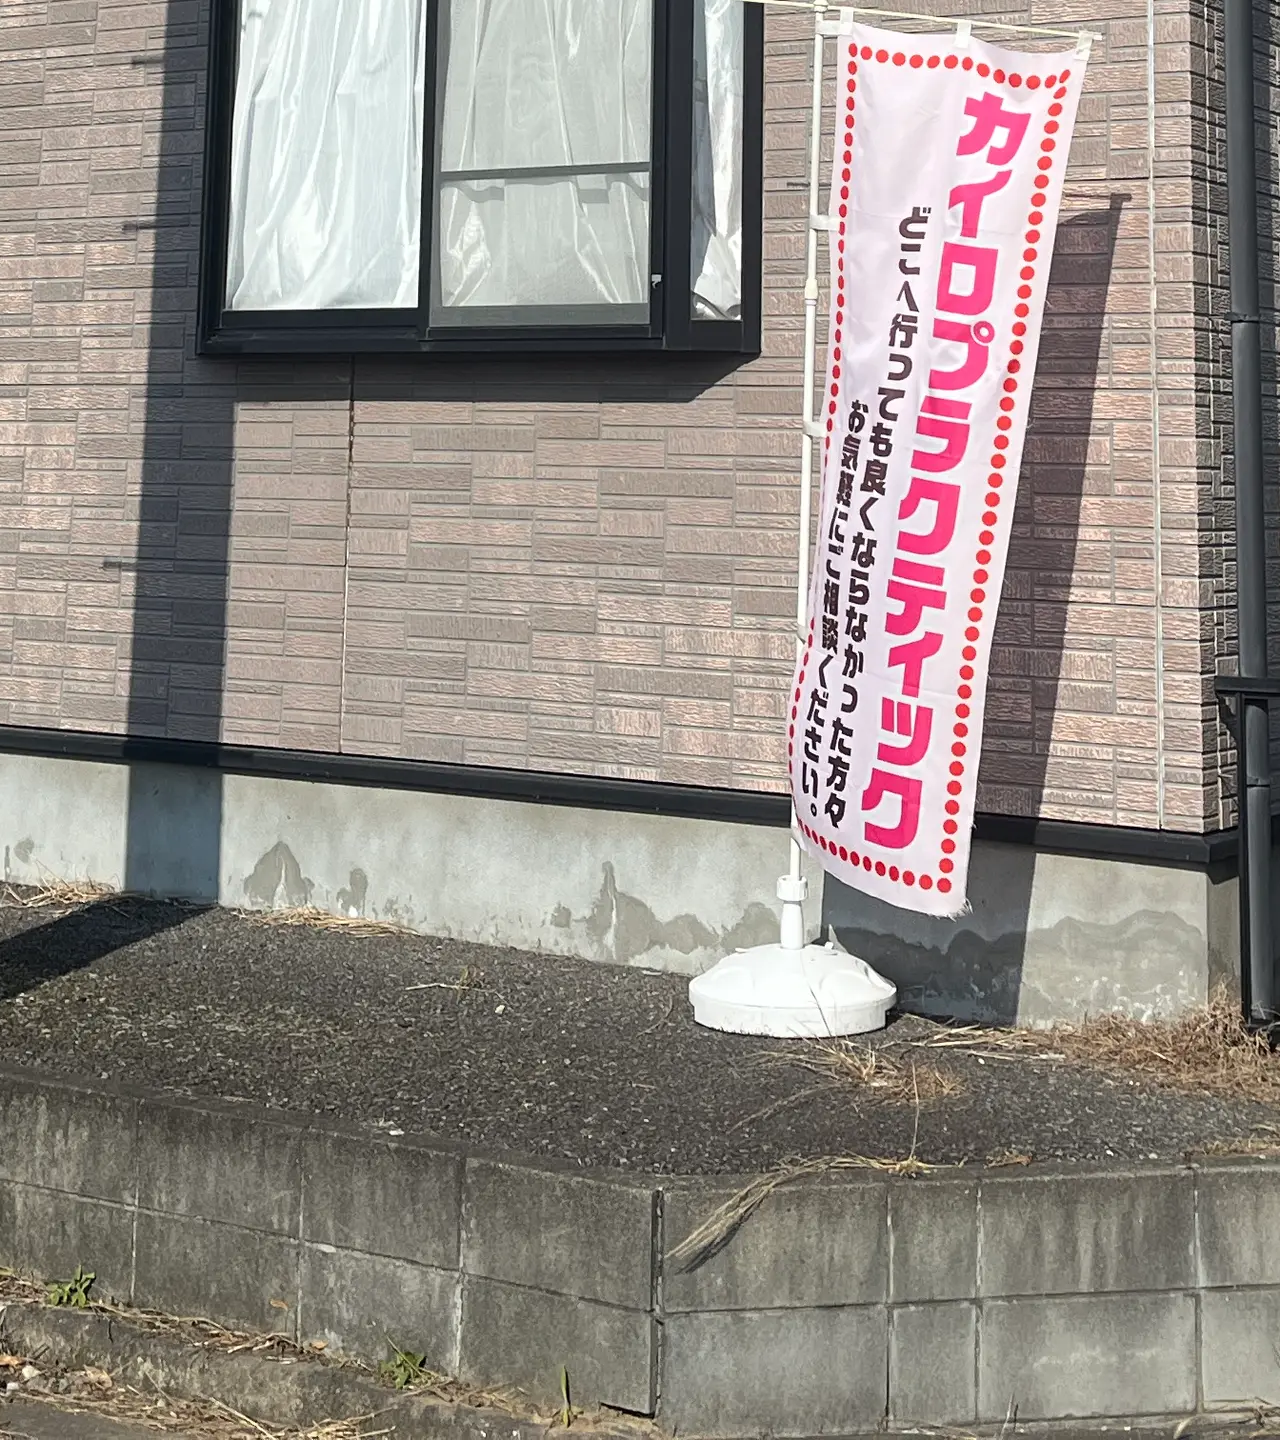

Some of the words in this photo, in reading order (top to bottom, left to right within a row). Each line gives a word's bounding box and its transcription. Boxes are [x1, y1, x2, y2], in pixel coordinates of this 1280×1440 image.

[801, 399, 869, 817] お気軽にご相談ください。
[824, 206, 932, 829] どこへ行っても良くならなかった方々
[861, 91, 1031, 849] カイロプラクティック
